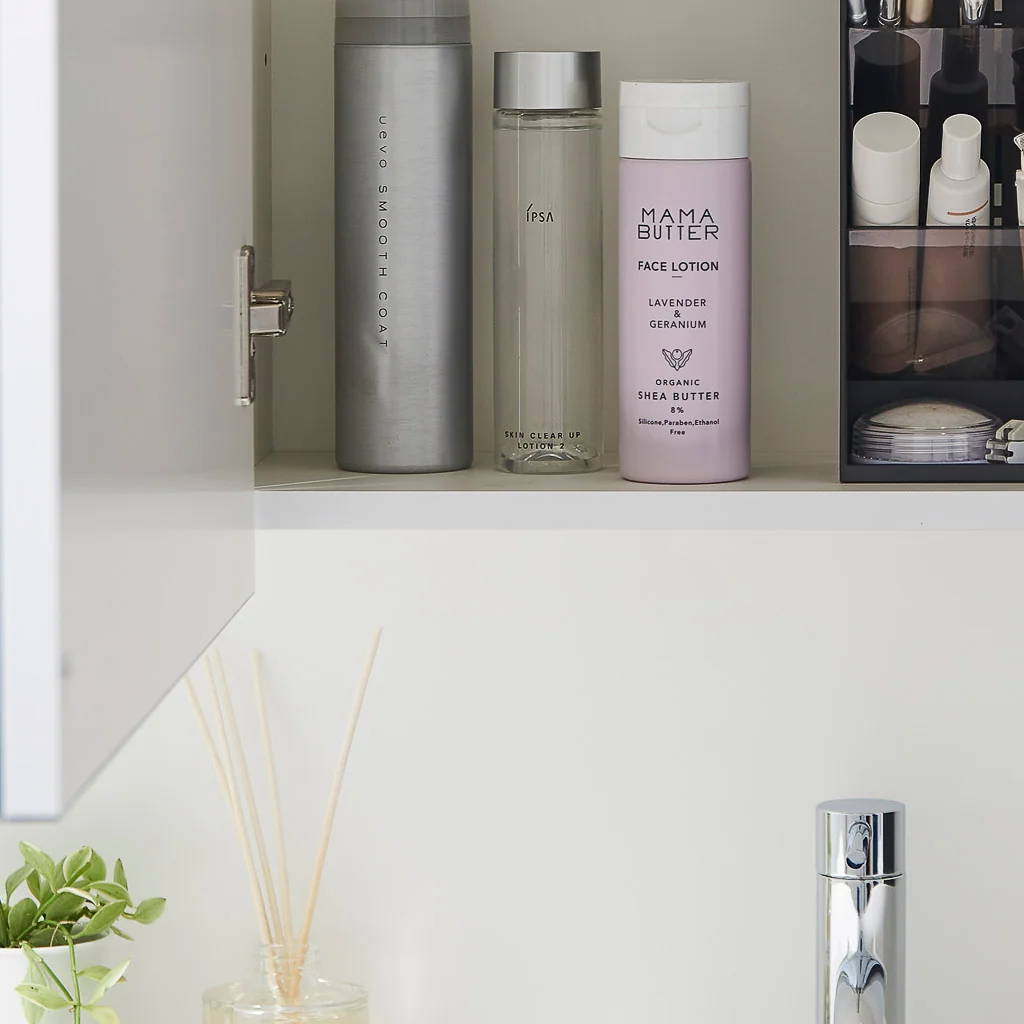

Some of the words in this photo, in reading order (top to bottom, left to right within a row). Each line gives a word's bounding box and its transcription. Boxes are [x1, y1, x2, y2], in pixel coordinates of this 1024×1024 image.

[641, 208, 715, 224] MAMA
[379, 184, 387, 277] SMOOTH
[637, 224, 719, 240] BUTTER
[638, 261, 667, 272] FACE
[671, 261, 719, 272] LOTION
[649, 298, 707, 308] LAVENDER
[379, 291, 387, 347] COAT
[673, 309, 681, 319] &
[649, 319, 707, 329] GERANIUM
[655, 378, 700, 386] ORGANIC
[638, 391, 667, 401] SHEA
[673, 391, 720, 401] BUTTER
[670, 406, 684, 414] 8%
[504, 431, 524, 439] SKIN
[530, 432, 563, 440] CLEAR
[569, 431, 581, 439] UP
[517, 442, 554, 450] LOTION
[559, 442, 565, 450] 2
